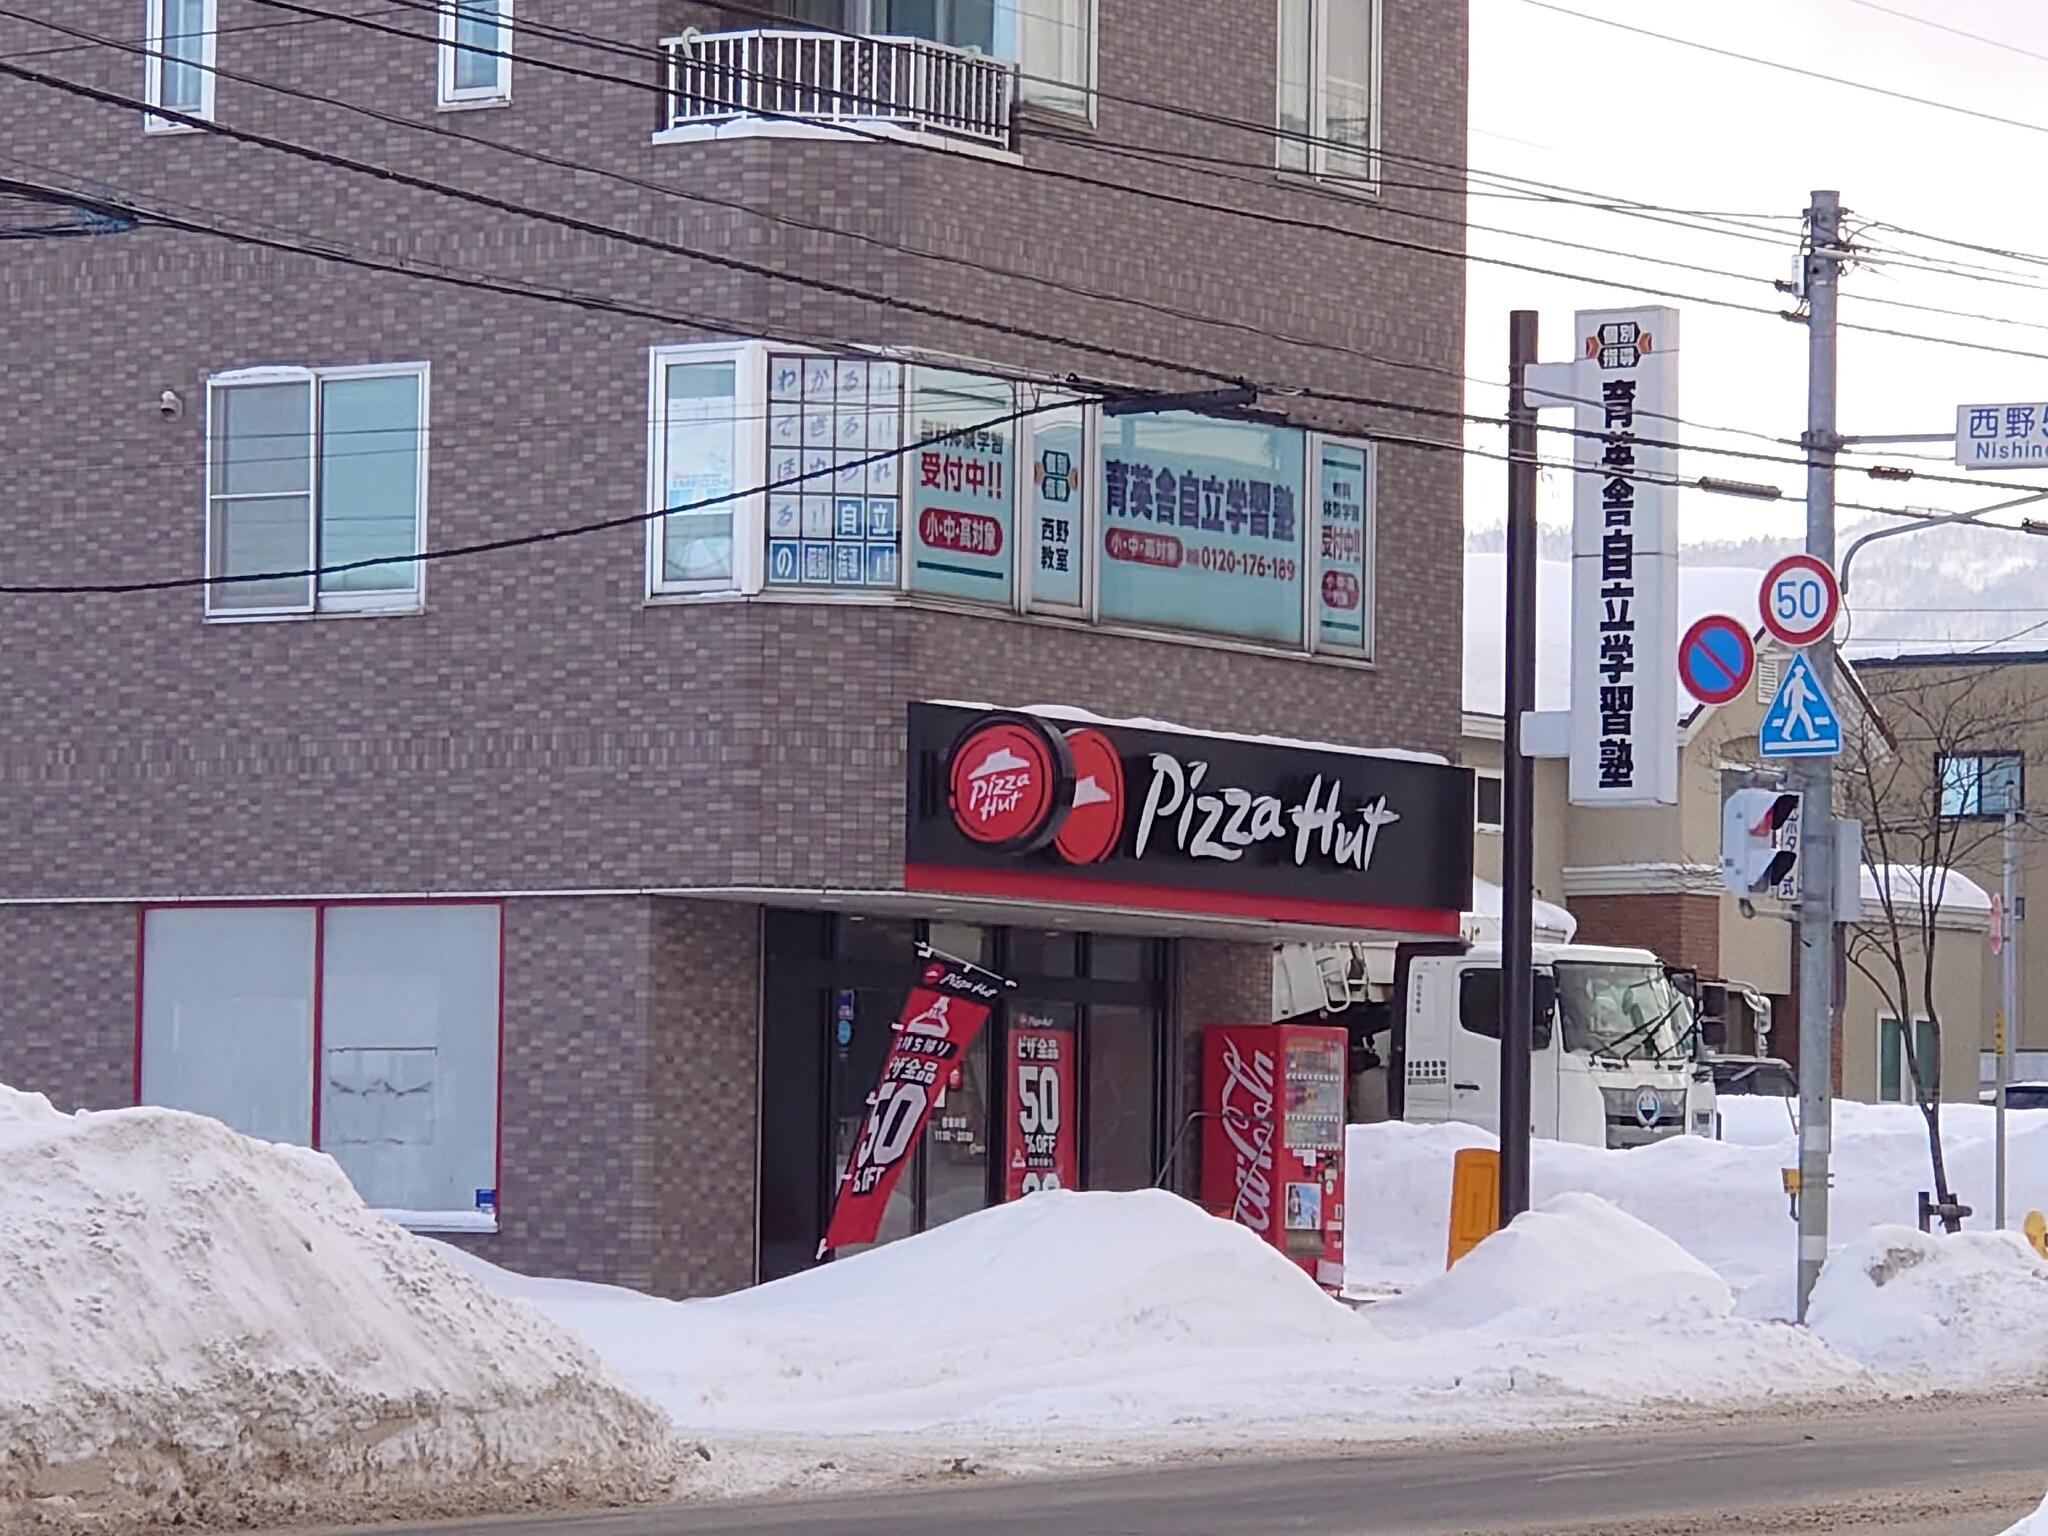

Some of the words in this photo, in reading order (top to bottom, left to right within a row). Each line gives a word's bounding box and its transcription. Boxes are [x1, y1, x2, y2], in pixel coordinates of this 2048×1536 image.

[1970, 406, 2048, 439] 西野
[1041, 517, 1069, 542] 西野
[1041, 547, 1069, 572] 教室
[1777, 580, 1820, 619] 50
[968, 773, 1031, 811] Pizza
[979, 791, 1023, 821] Hut
[1136, 752, 1286, 861] Pizza
[1285, 773, 1400, 871] Hut
[1018, 1066, 1060, 1134] 50
